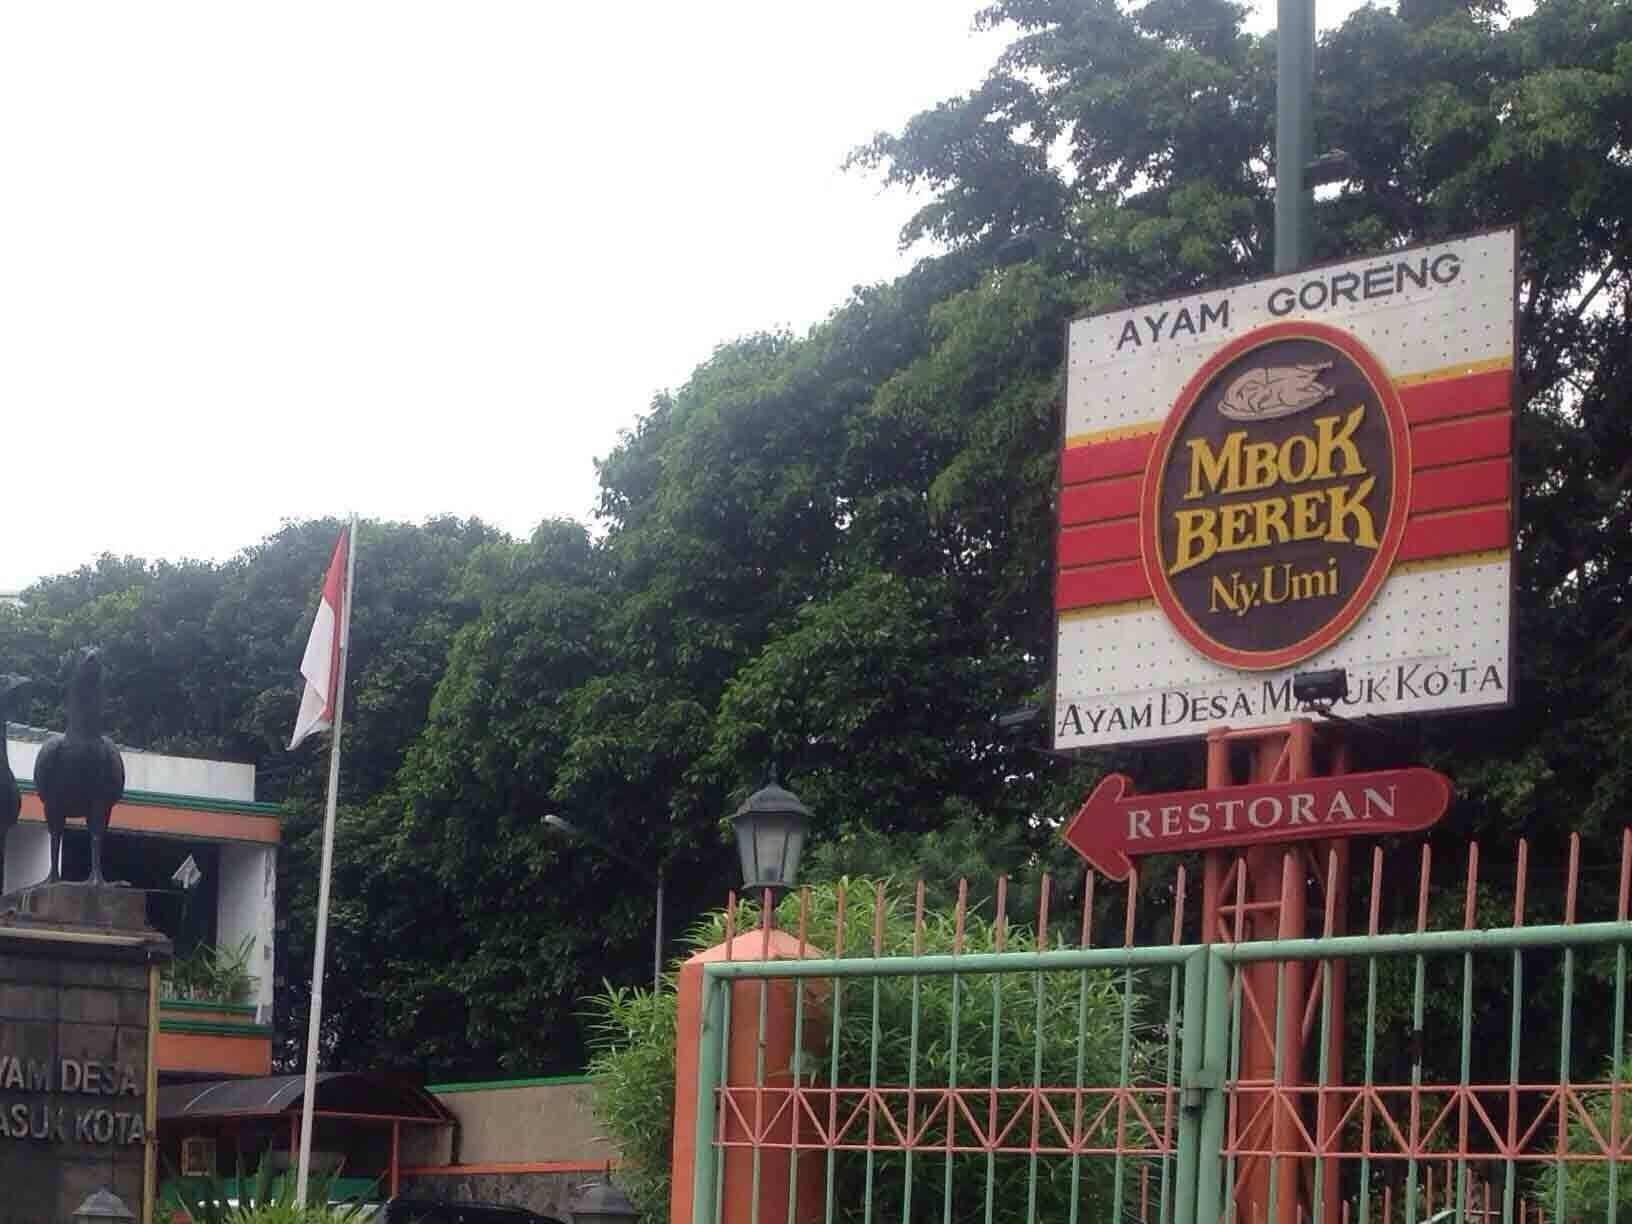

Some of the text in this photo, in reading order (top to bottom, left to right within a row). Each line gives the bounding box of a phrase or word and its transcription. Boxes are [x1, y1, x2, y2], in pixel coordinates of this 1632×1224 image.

[1114, 251, 1462, 352] AYAM GORENG
[1169, 475, 1379, 576] BEREK
[1057, 662, 1504, 738] AYAM DESA MUK KOTA
[1126, 784, 1399, 841] RESTORAN
[61, 1059, 140, 1097] DESA
[74, 1109, 145, 1146] KOTA
